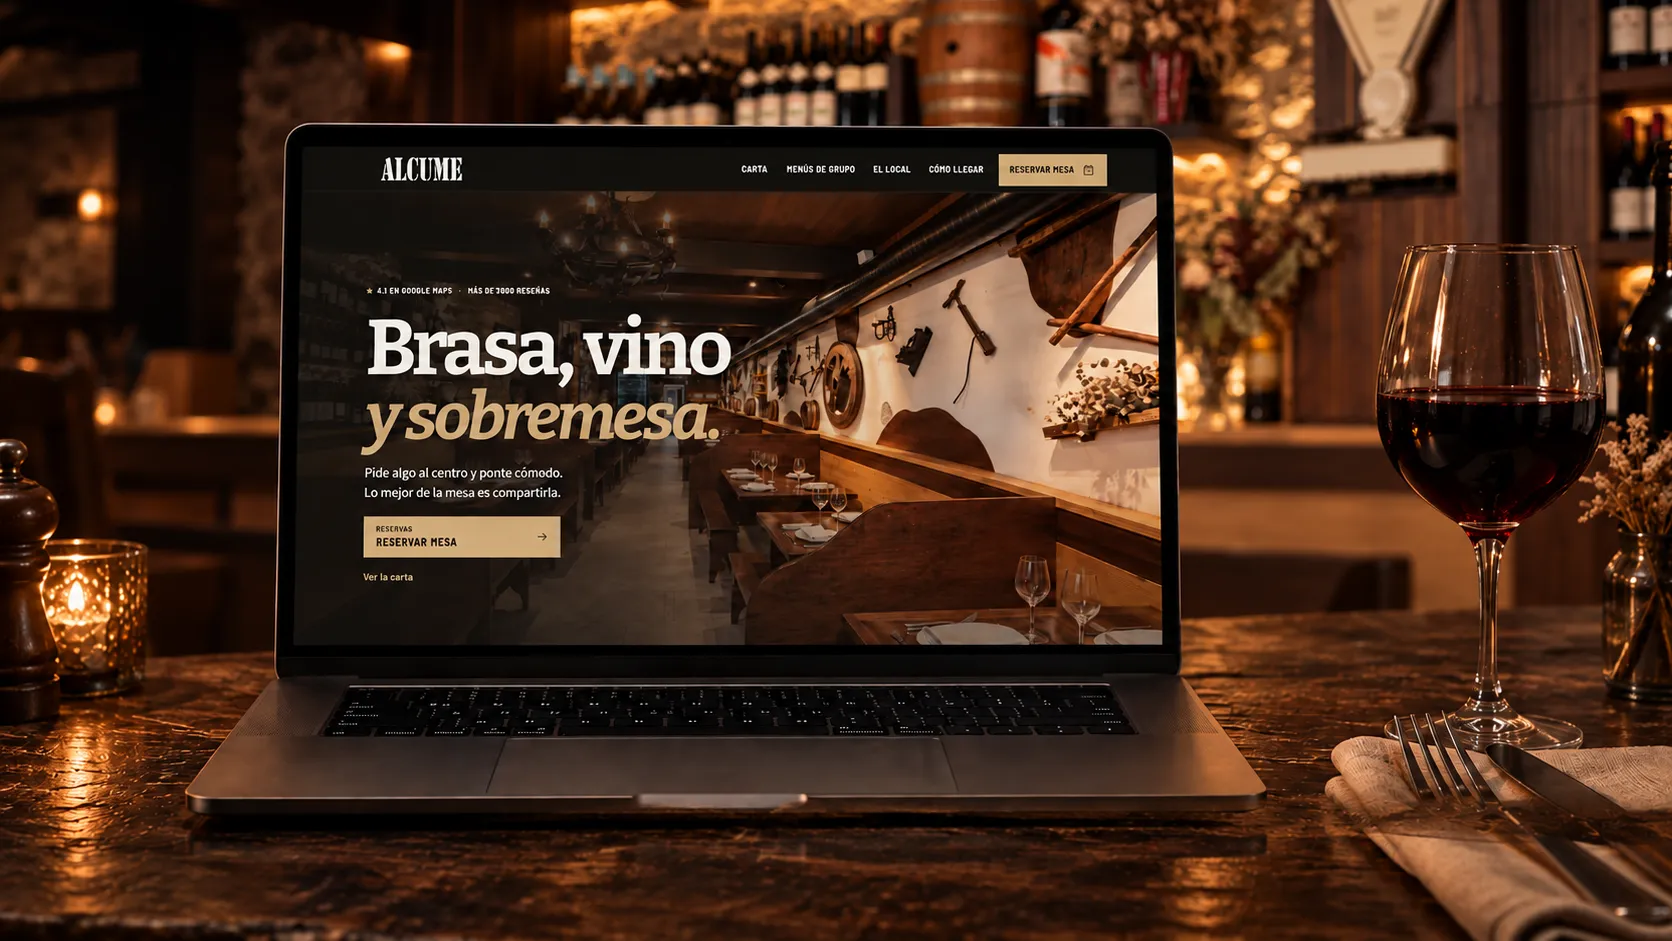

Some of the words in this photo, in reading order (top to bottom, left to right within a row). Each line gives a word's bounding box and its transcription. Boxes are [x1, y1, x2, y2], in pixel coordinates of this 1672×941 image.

[381, 156, 463, 182] ALCUME
[741, 164, 768, 174] CARTA
[786, 162, 814, 174] MENÚS
[816, 164, 827, 174] DE
[828, 164, 856, 174] GRUPO
[873, 165, 883, 174] EL
[885, 165, 911, 174] LOCAL
[929, 162, 951, 174] CÓMO
[953, 165, 984, 174] LLEGAR
[1009, 165, 1050, 174] RESERVAR
[1052, 165, 1075, 174] MESA
[376, 287, 388, 295] 4.1
[389, 287, 400, 295] EN
[432, 287, 453, 295] MAPS
[467, 285, 483, 295] MÁS
[484, 287, 494, 295] DE
[516, 285, 551, 295] RESEÑAS
[367, 318, 574, 388] Brasa,
[583, 313, 732, 376] vino
[360, 403, 403, 456] y
[404, 387, 720, 440] sobremesa.
[364, 466, 390, 479] Pide
[392, 467, 416, 482] algo
[418, 467, 429, 479] al
[431, 468, 468, 479] centro
[470, 469, 478, 481] y
[479, 468, 513, 481] ponte
[514, 466, 563, 479] cómodo.
[364, 487, 379, 498] Lo
[380, 486, 414, 501] mejor
[416, 487, 431, 498] de
[432, 486, 443, 498] la
[445, 489, 475, 498] mesa
[477, 489, 491, 498] es
[492, 486, 561, 501] compartirla.
[375, 525, 413, 533] RESERVAS
[376, 537, 427, 547] RESERVAR
[430, 537, 458, 547] MESA
[363, 573, 378, 581] Ver
[380, 572, 389, 581] la
[390, 573, 414, 581] carta
